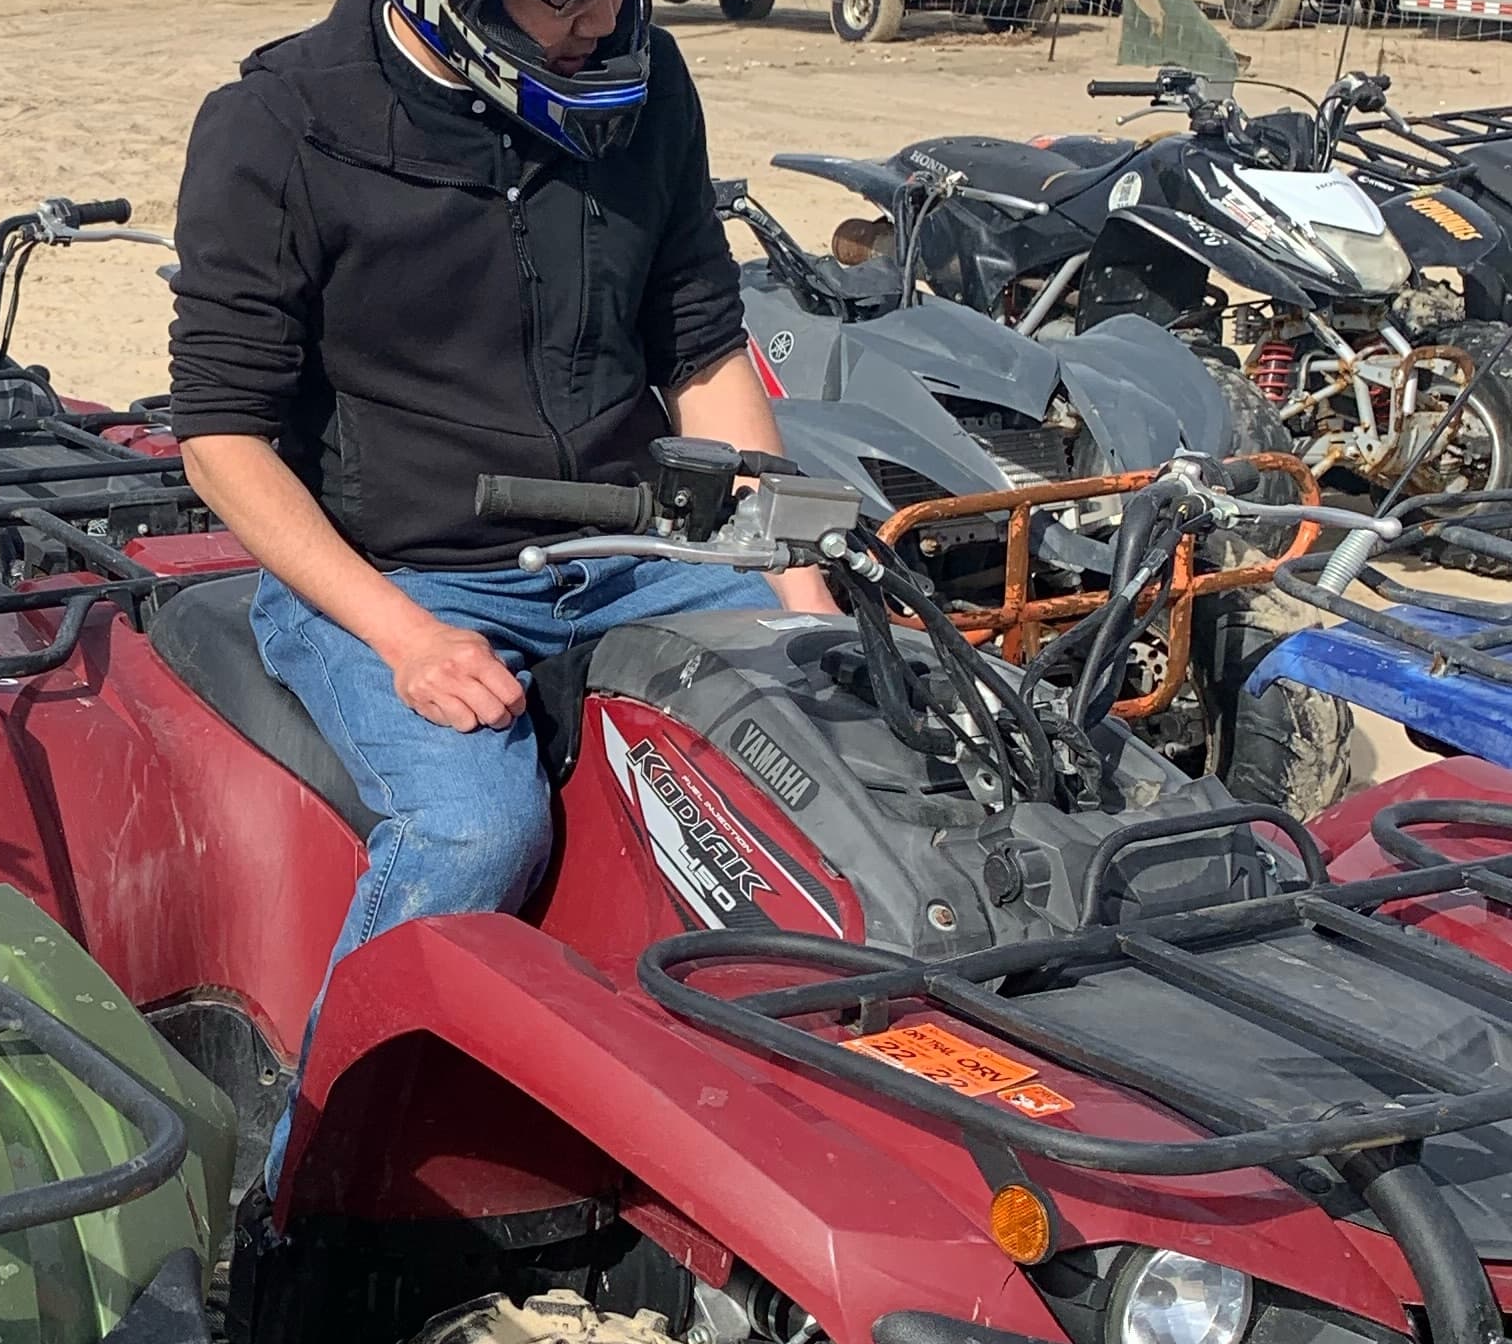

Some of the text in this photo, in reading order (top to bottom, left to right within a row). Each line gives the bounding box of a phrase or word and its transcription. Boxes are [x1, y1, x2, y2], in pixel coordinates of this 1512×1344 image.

[737, 722, 813, 807] YAMAHA
[626, 737, 781, 902] KODIAK
[680, 774, 755, 854] FUEL INJECTION
[678, 844, 738, 914] 450
[871, 1041, 917, 1062] 22
[956, 1057, 1014, 1083] ORV
